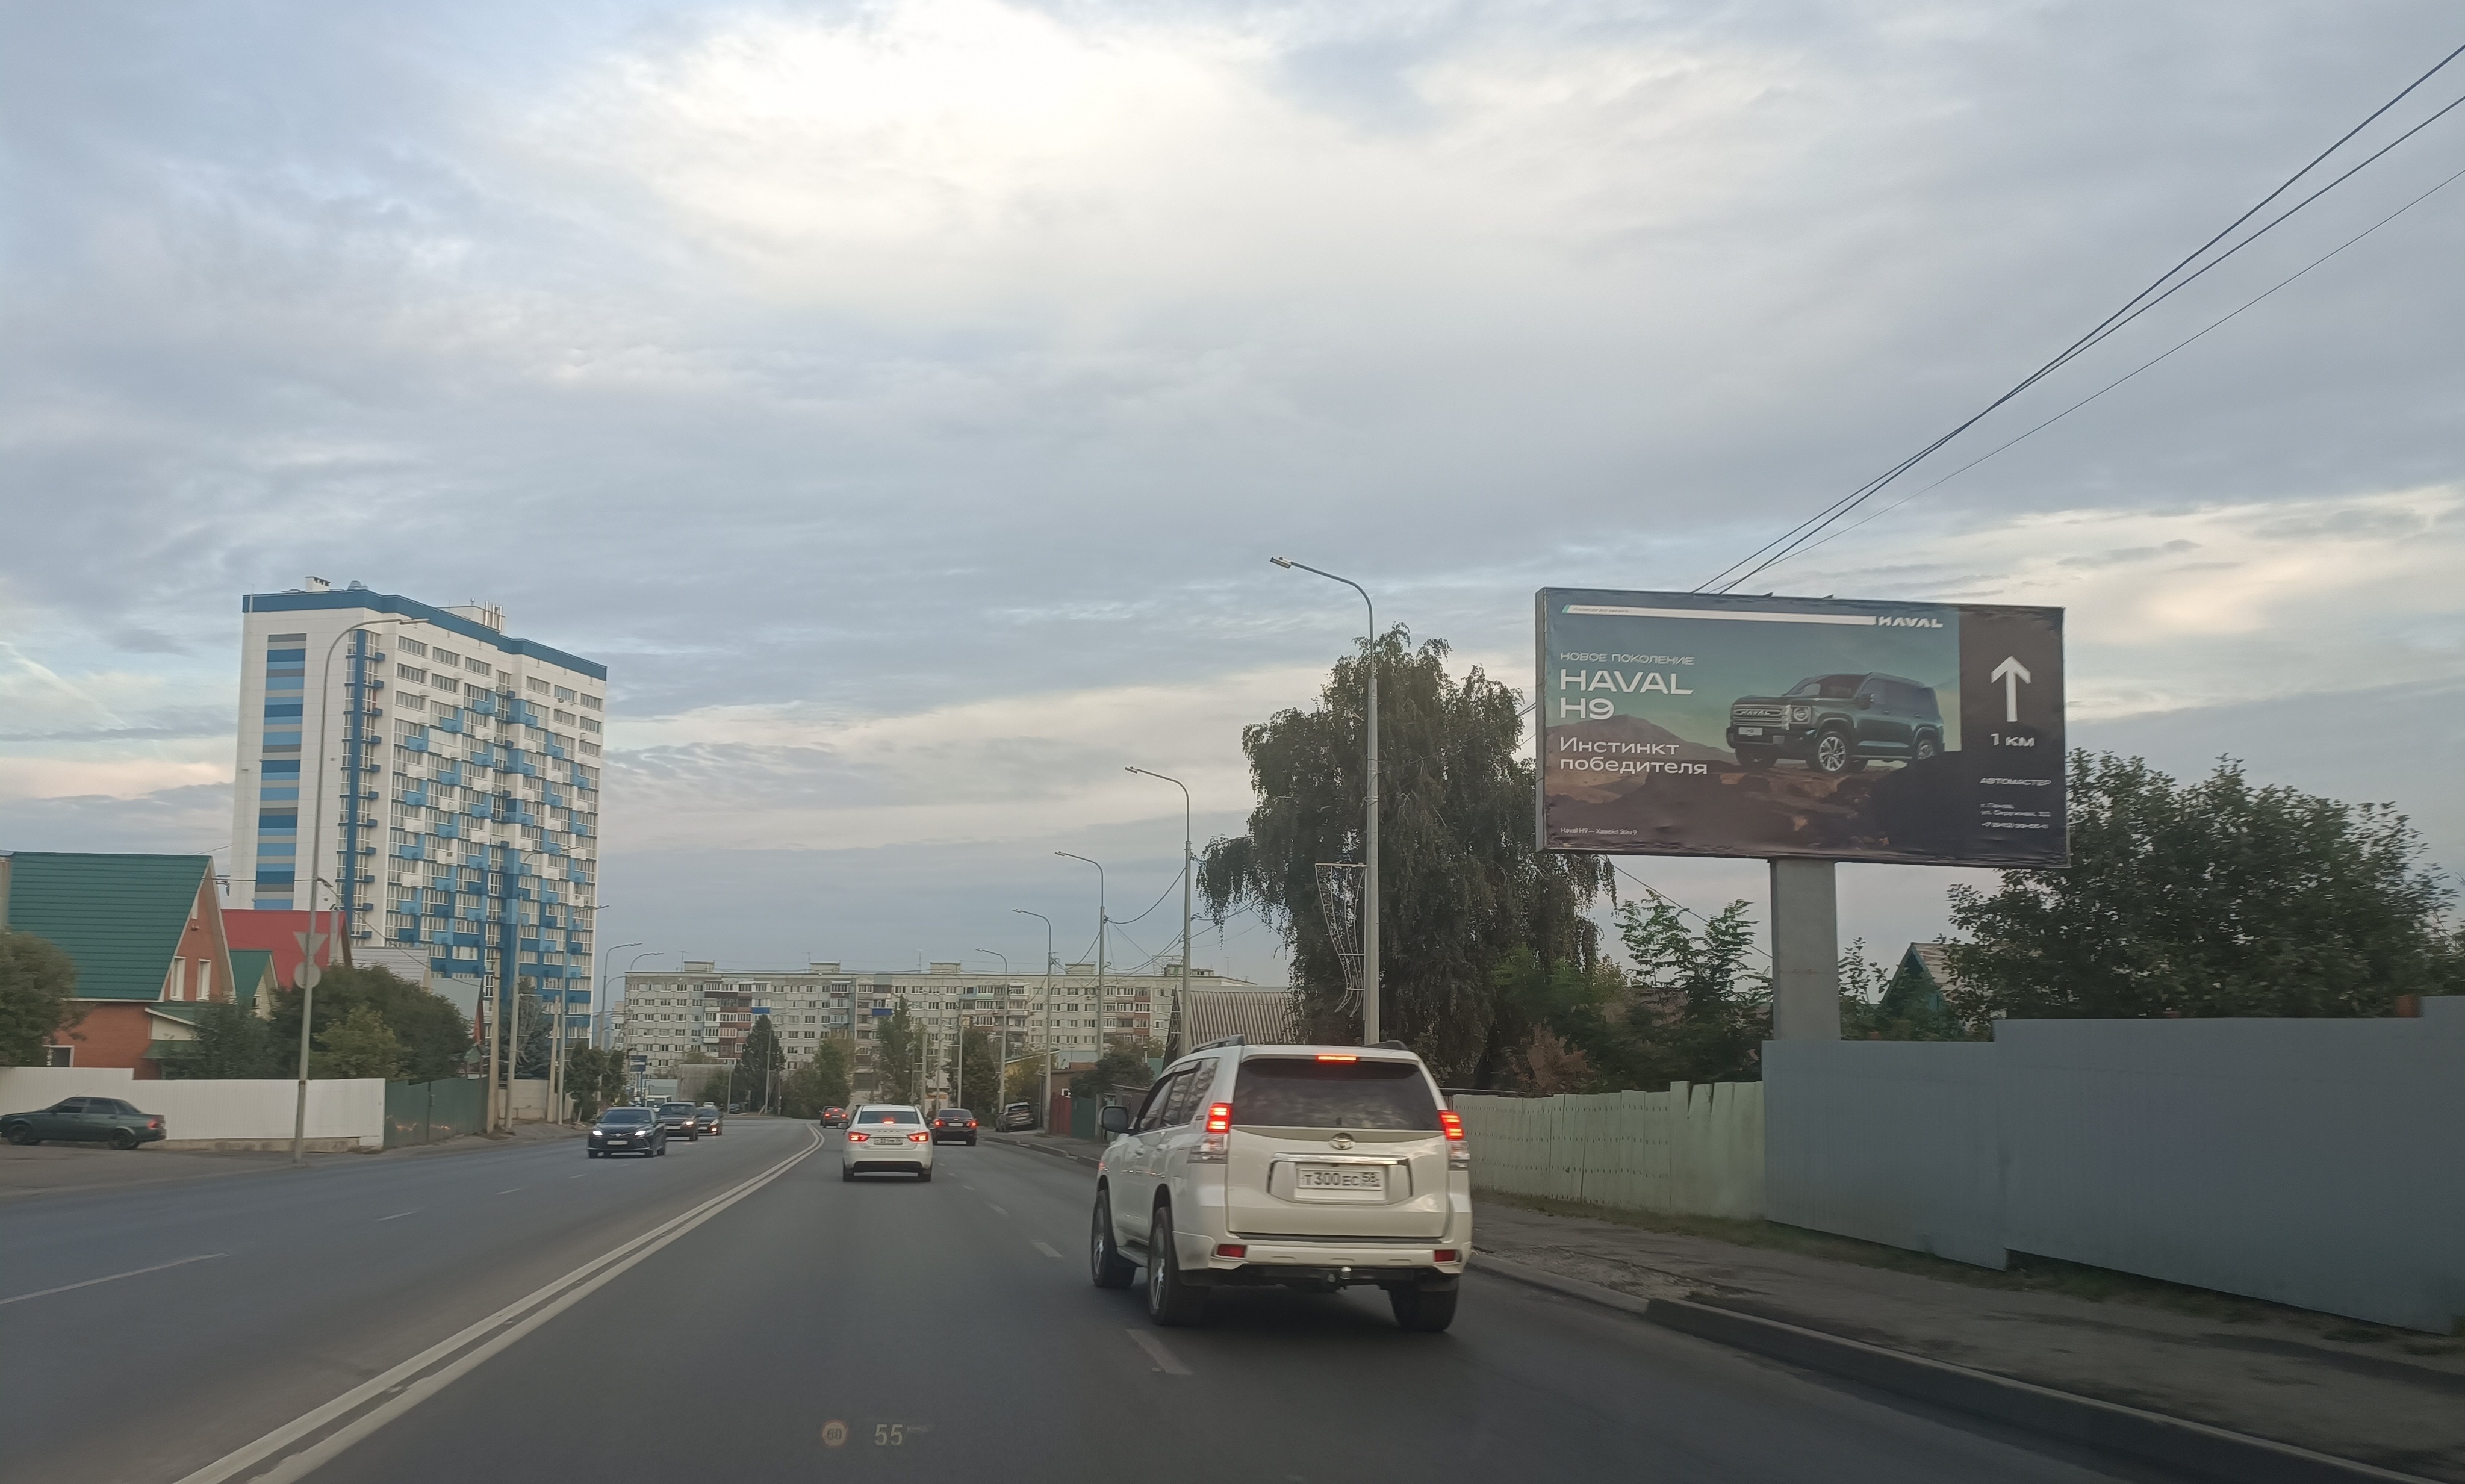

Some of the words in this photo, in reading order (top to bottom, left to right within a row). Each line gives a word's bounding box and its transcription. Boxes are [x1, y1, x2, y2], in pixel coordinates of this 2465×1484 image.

[1878, 616, 1944, 628] HAVAL
[1560, 652, 1608, 662] НОВОЕ
[1611, 654, 1695, 665] ПОКОЛЕНИЕ
[1560, 668, 1694, 695] HAVAL
[1560, 697, 1615, 720] H9
[1560, 736, 1680, 755] Инстинкт
[1990, 733, 2000, 746] 1
[1560, 756, 1708, 775] победителя
[874, 1424, 903, 1446] 55
